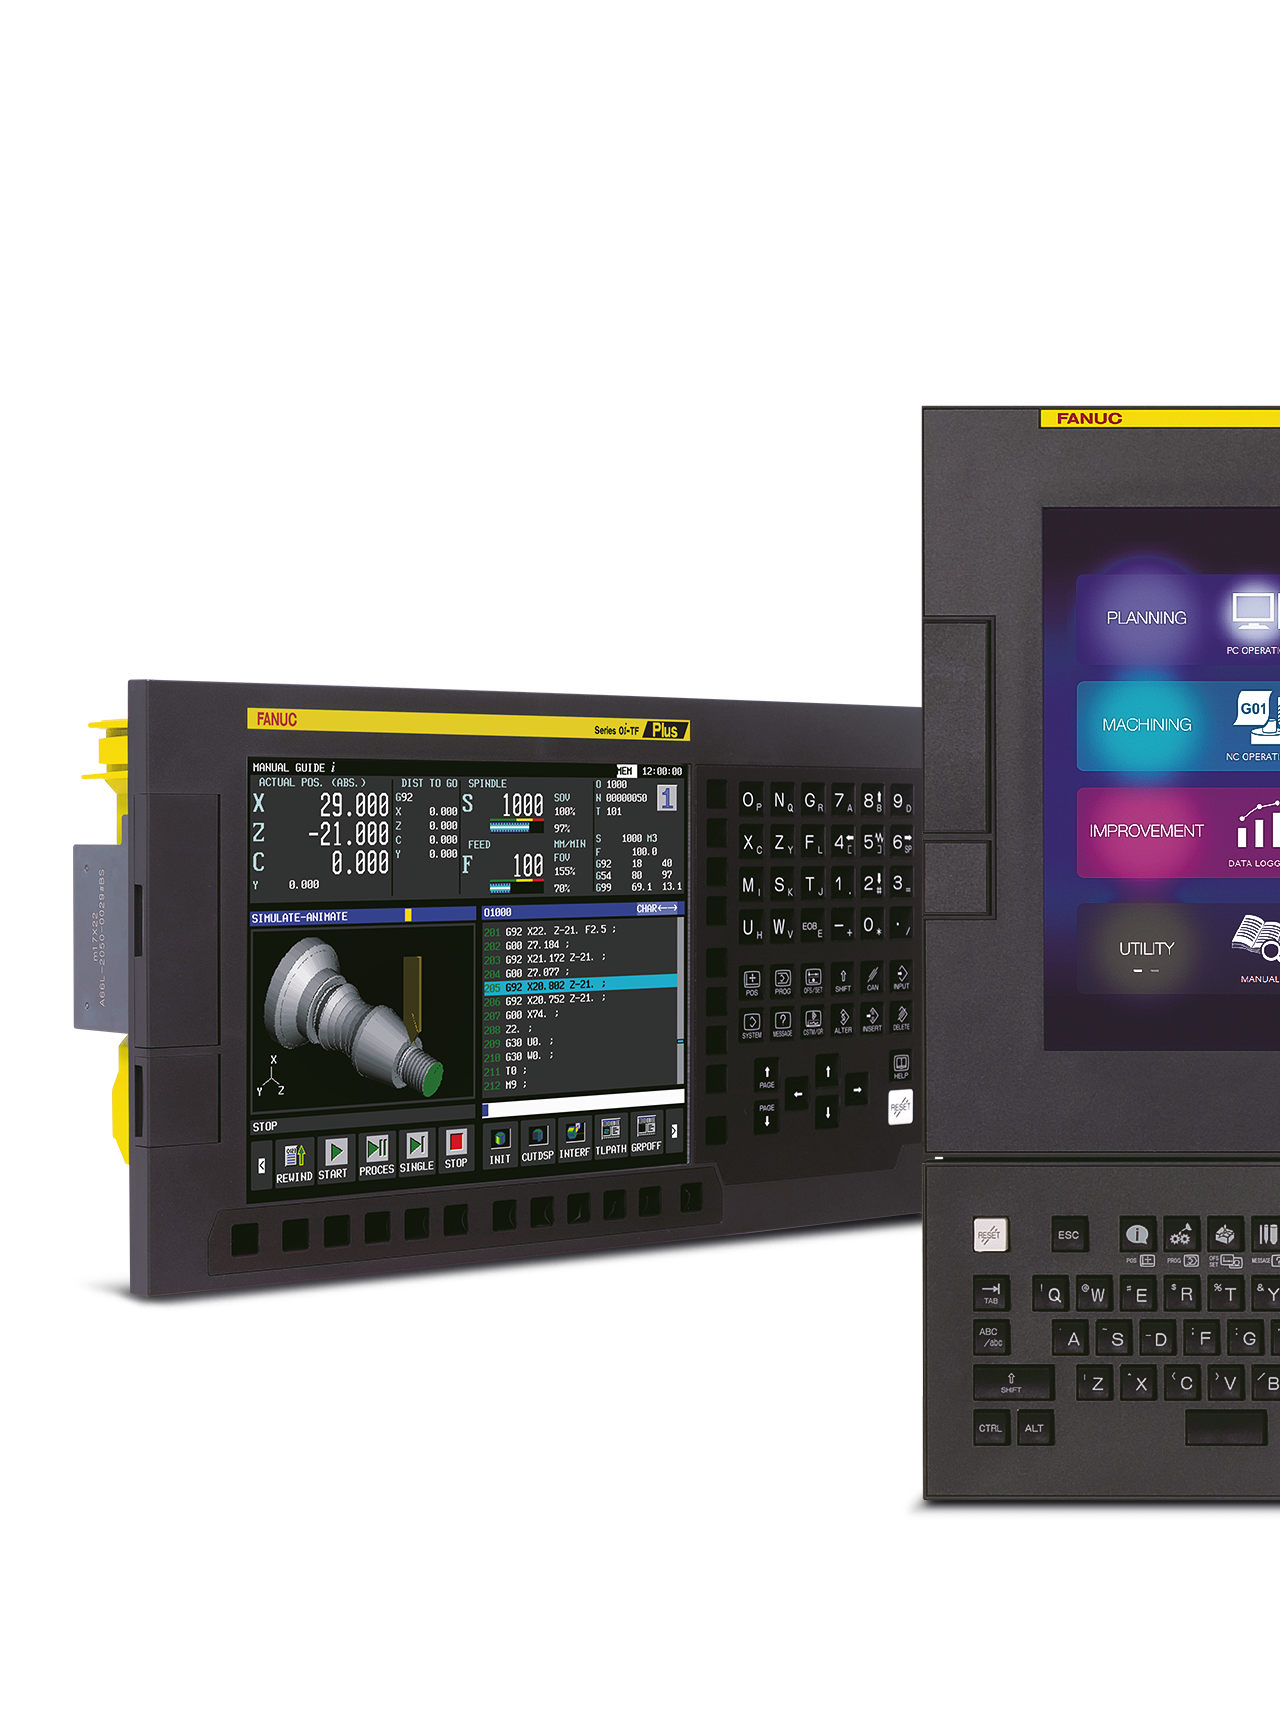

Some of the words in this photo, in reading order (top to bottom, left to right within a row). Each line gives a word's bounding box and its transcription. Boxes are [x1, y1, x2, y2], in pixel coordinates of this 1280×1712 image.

[1057, 413, 1123, 425] FANUC
[1107, 611, 1187, 625] PLANNING
[1227, 647, 1239, 655] PC
[1241, 702, 1266, 715] G01
[257, 712, 297, 726] FANUC
[1103, 718, 1192, 731] MACHINING
[594, 726, 616, 735] Series
[652, 722, 678, 738] Plus
[1226, 753, 1240, 761] NC
[253, 763, 289, 772] MANUAL
[295, 763, 326, 772] GUIDE
[642, 767, 683, 776] 12:00:00
[259, 778, 295, 787] ACTUAL
[301, 778, 323, 787] POS.
[331, 778, 366, 787] (ABS.)
[401, 779, 423, 787] DIST
[430, 779, 441, 787] TO
[446, 779, 458, 787] GO
[468, 779, 507, 788] SPINDLE
[606, 794, 647, 802] 00000050
[320, 792, 389, 817] 29.000
[503, 793, 543, 816] 1000
[555, 807, 575, 815] 100%
[309, 821, 389, 846] -21.000
[1090, 824, 1205, 838] IMPROVEMENT
[468, 840, 491, 849] FEED
[554, 839, 586, 849] MM/MIN
[332, 850, 389, 875] 0.000
[514, 853, 543, 877] 100
[1228, 859, 1252, 868] DATA
[252, 912, 348, 923] SIMULATE-ANIMATE
[484, 928, 500, 937] 201
[505, 927, 522, 936] G92
[527, 926, 547, 936] X22.
[554, 925, 578, 935] Z-21.
[585, 925, 607, 934] F2.5
[1120, 942, 1175, 956] UTILITY
[1241, 975, 1279, 983] MANUAL
[891, 1103, 910, 1111] RESET
[253, 1121, 278, 1132] STOP
[596, 1144, 627, 1156] TLPATH
[631, 1141, 662, 1152] GRPOFF
[522, 1151, 554, 1162] CUTDSP
[560, 1148, 590, 1158] INTERF
[445, 1158, 467, 1169] STOP
[490, 1154, 511, 1165] INIT
[360, 1165, 395, 1175] PROCES
[400, 1161, 434, 1172] SINGLE
[276, 1172, 313, 1183] REWIND
[318, 1169, 347, 1179] START
[1058, 1231, 1079, 1239] ESC
[979, 1328, 997, 1336] ABC
[979, 1424, 1002, 1432] CTRL
[1025, 1424, 1044, 1432] ALT
